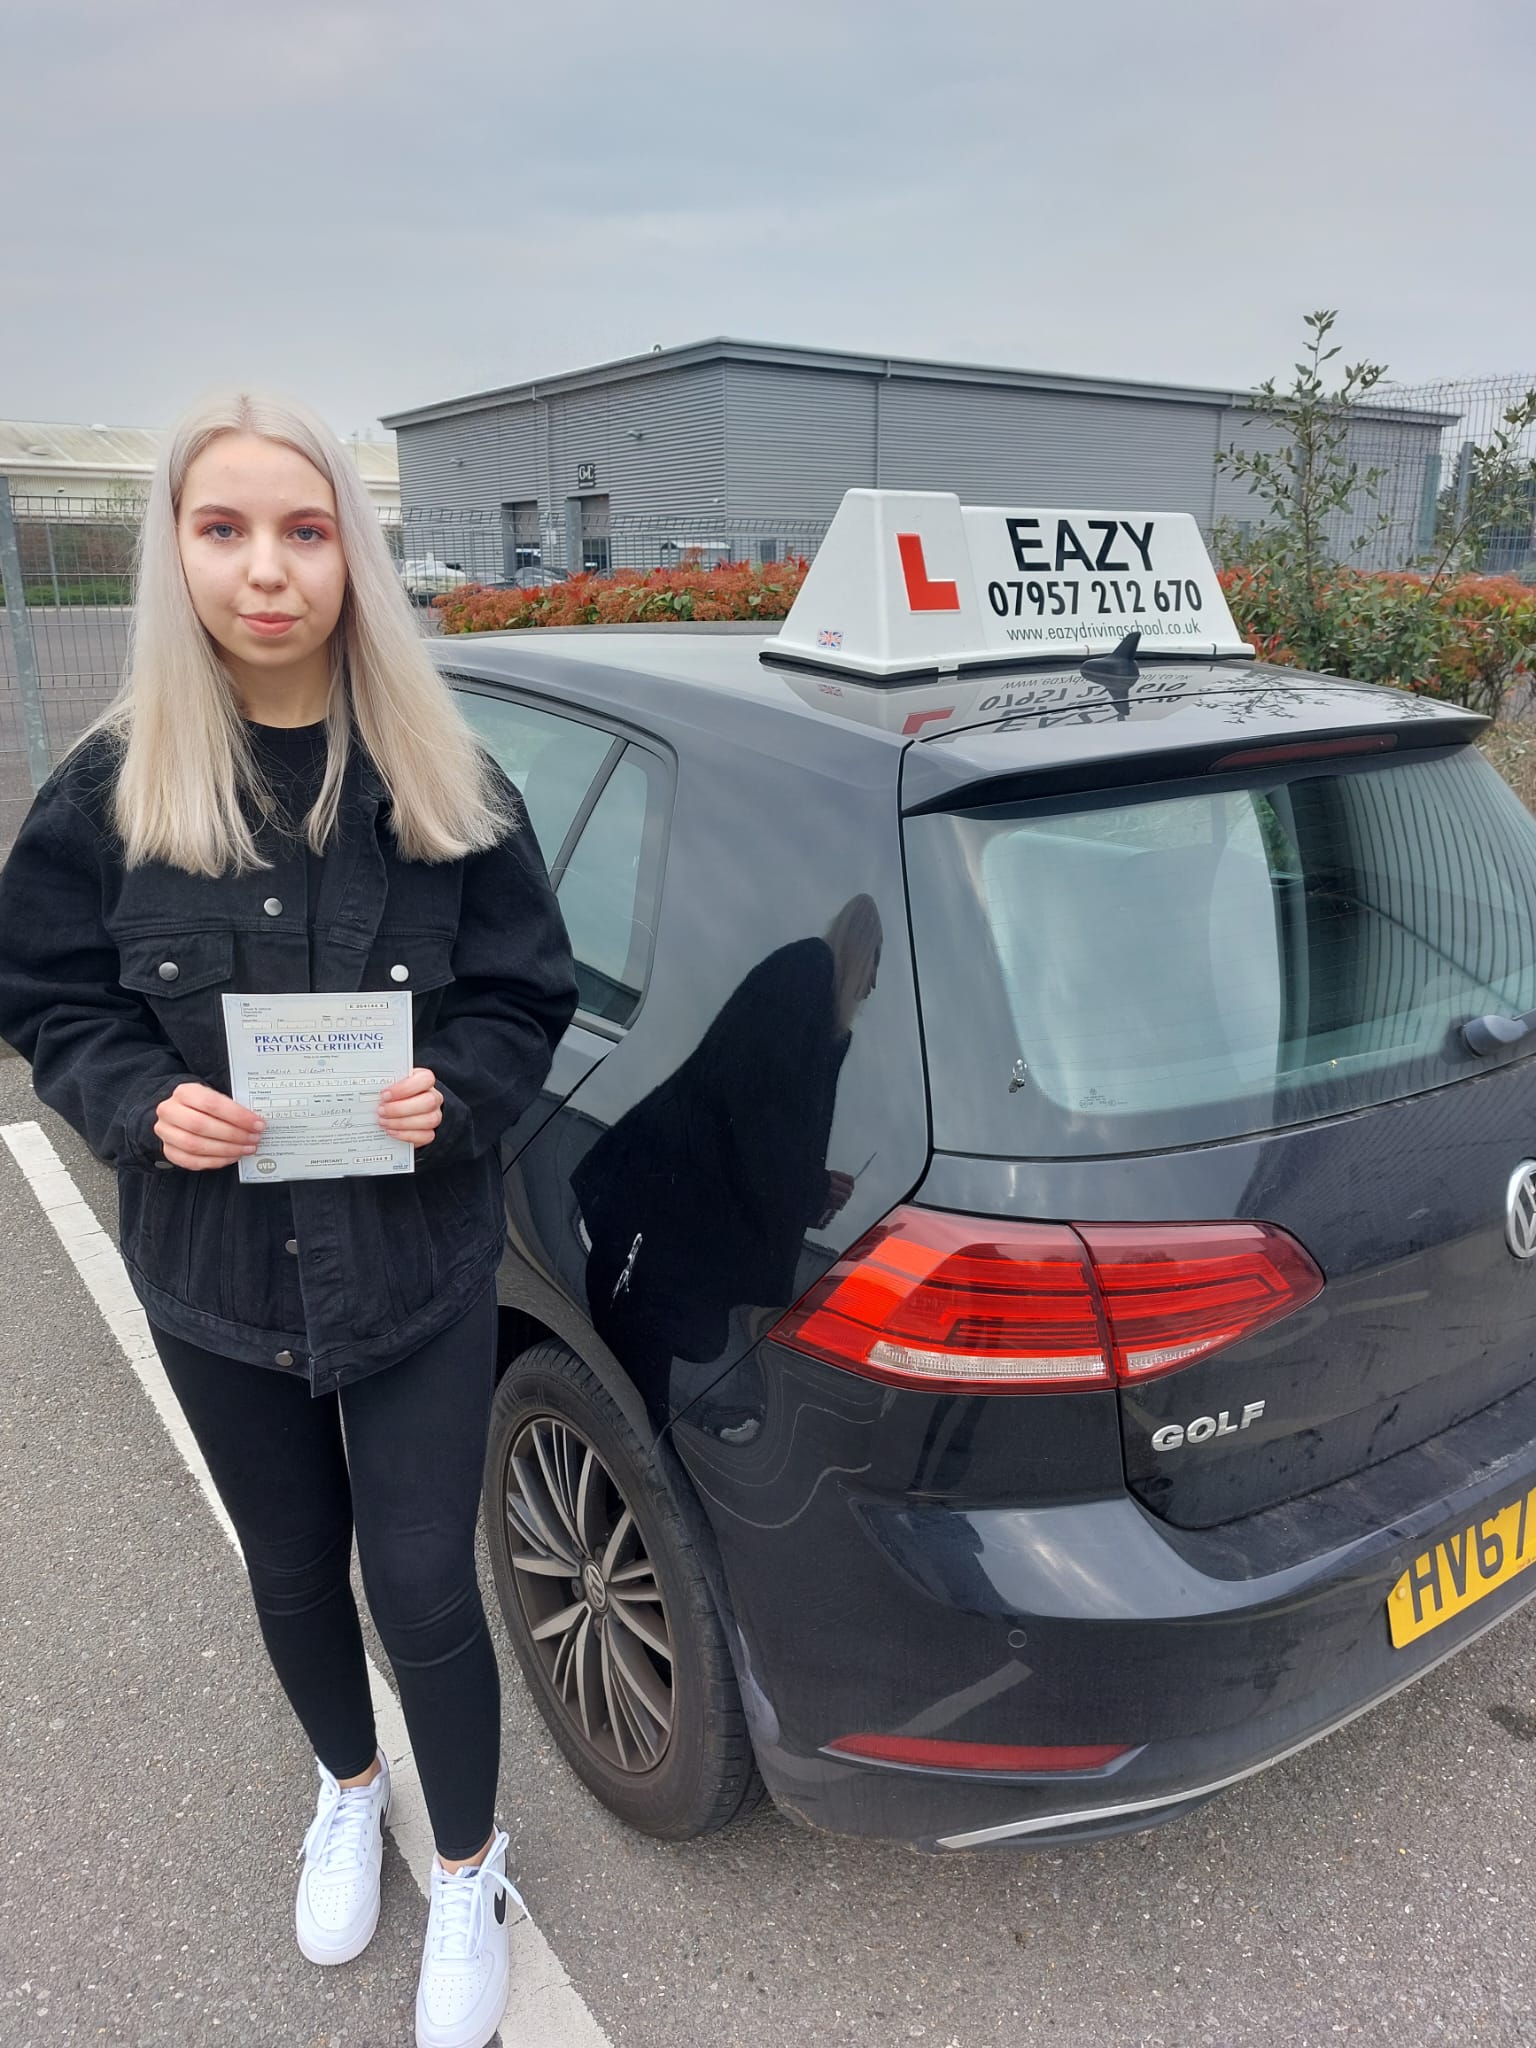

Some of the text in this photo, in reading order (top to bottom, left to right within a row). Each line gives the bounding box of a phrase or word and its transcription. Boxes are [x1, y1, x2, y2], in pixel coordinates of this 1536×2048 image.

[1005, 518, 1155, 571] EAZY
[896, 532, 961, 611] L
[988, 579, 1202, 617] 07957 212 670
[1006, 617, 1201, 642] www.eazydrivingschool.co.uk
[254, 1032, 384, 1044] PRACTICAL DRIVING
[256, 1041, 384, 1053] TEST PASS CERTIFICATE
[1151, 1400, 1265, 1452] GOLF
[1408, 1485, 1529, 1625] HV67
